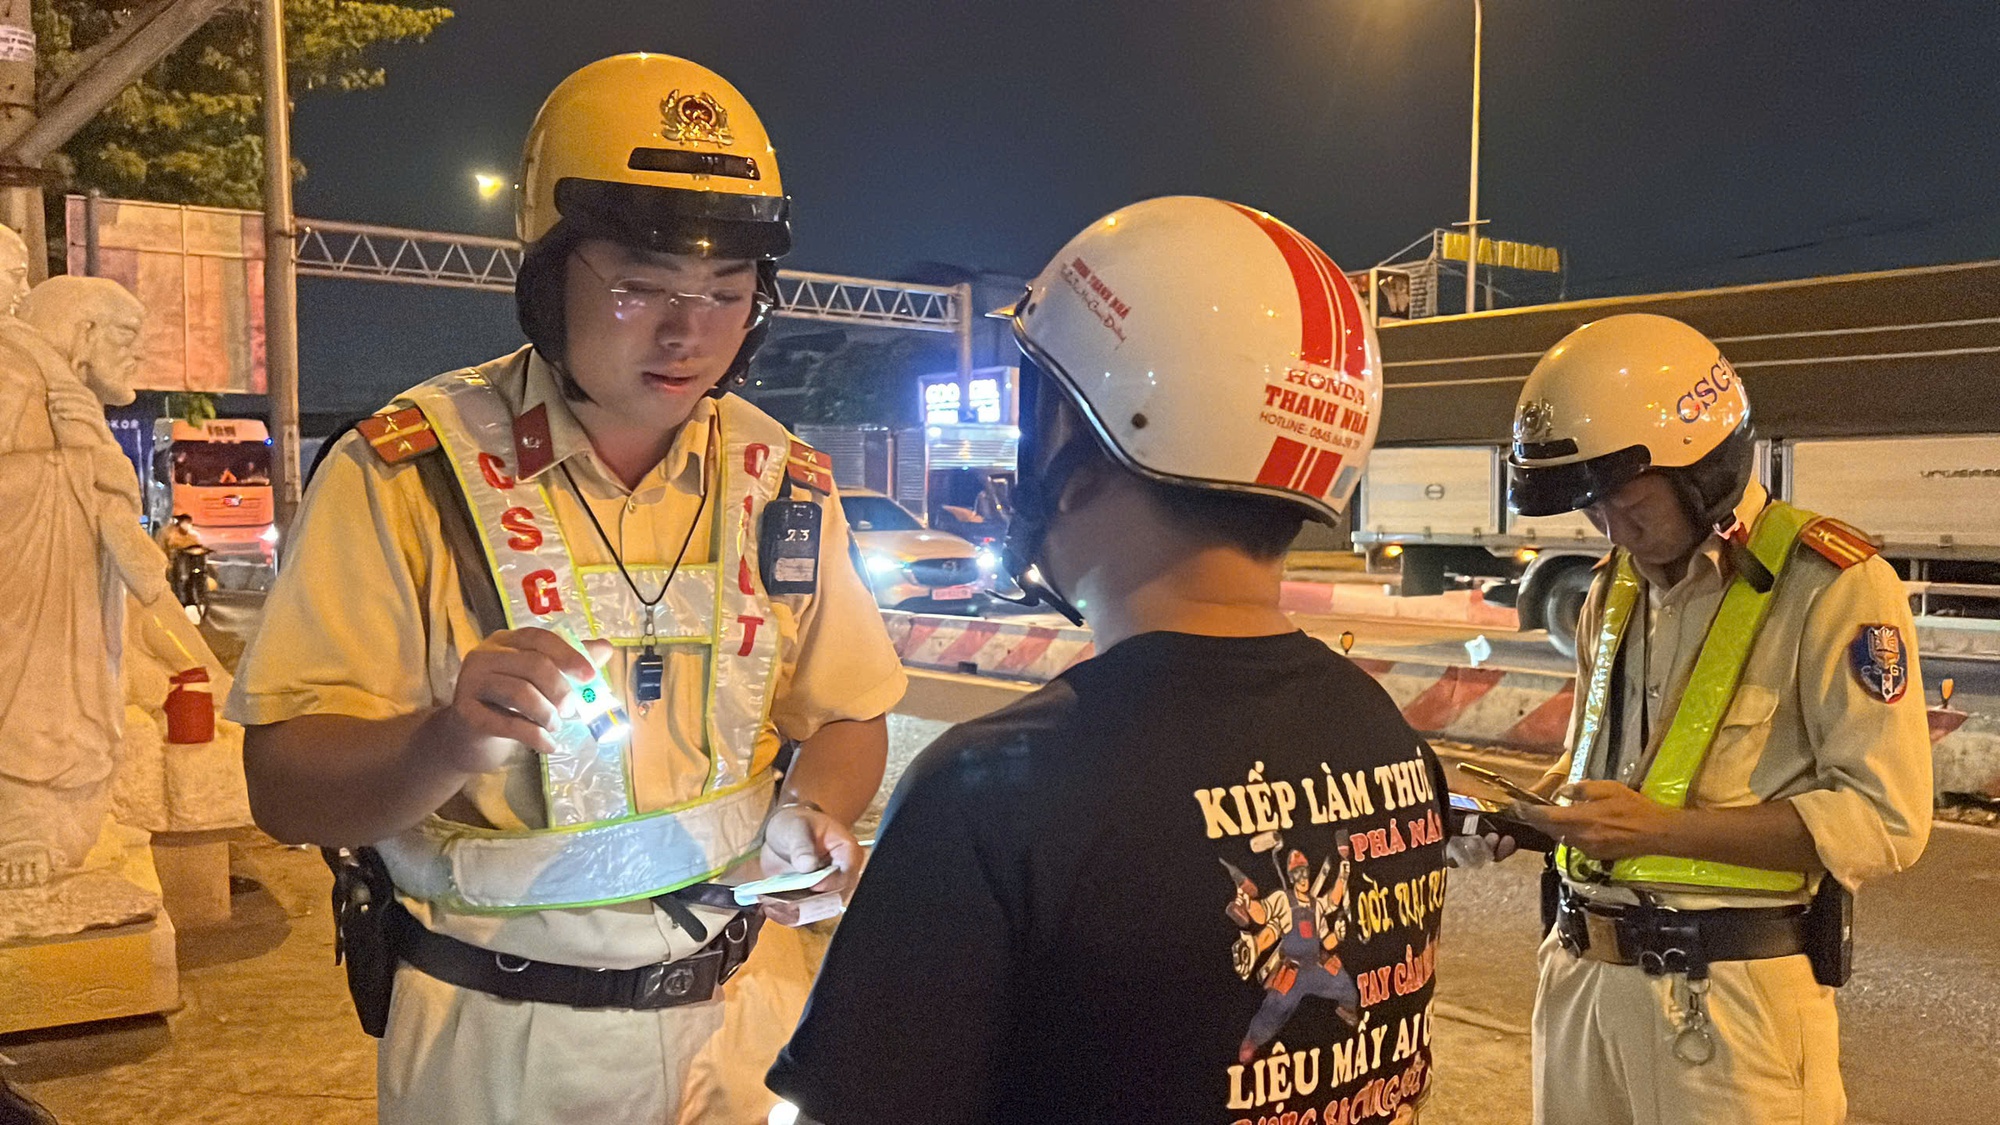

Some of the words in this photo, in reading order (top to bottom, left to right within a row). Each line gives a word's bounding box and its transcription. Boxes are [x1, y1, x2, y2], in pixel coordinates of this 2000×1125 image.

[1265, 384, 1339, 425] THANH
[1285, 369, 1365, 405] HONDA
[1194, 760, 1297, 839] KIẾP
[1301, 762, 1375, 824] LÀM
[1349, 817, 1406, 862] PHÁ
[1357, 965, 1392, 1008] TAY
[1226, 1041, 1321, 1114] LIỆU
[1331, 1010, 1388, 1088] MẤY
